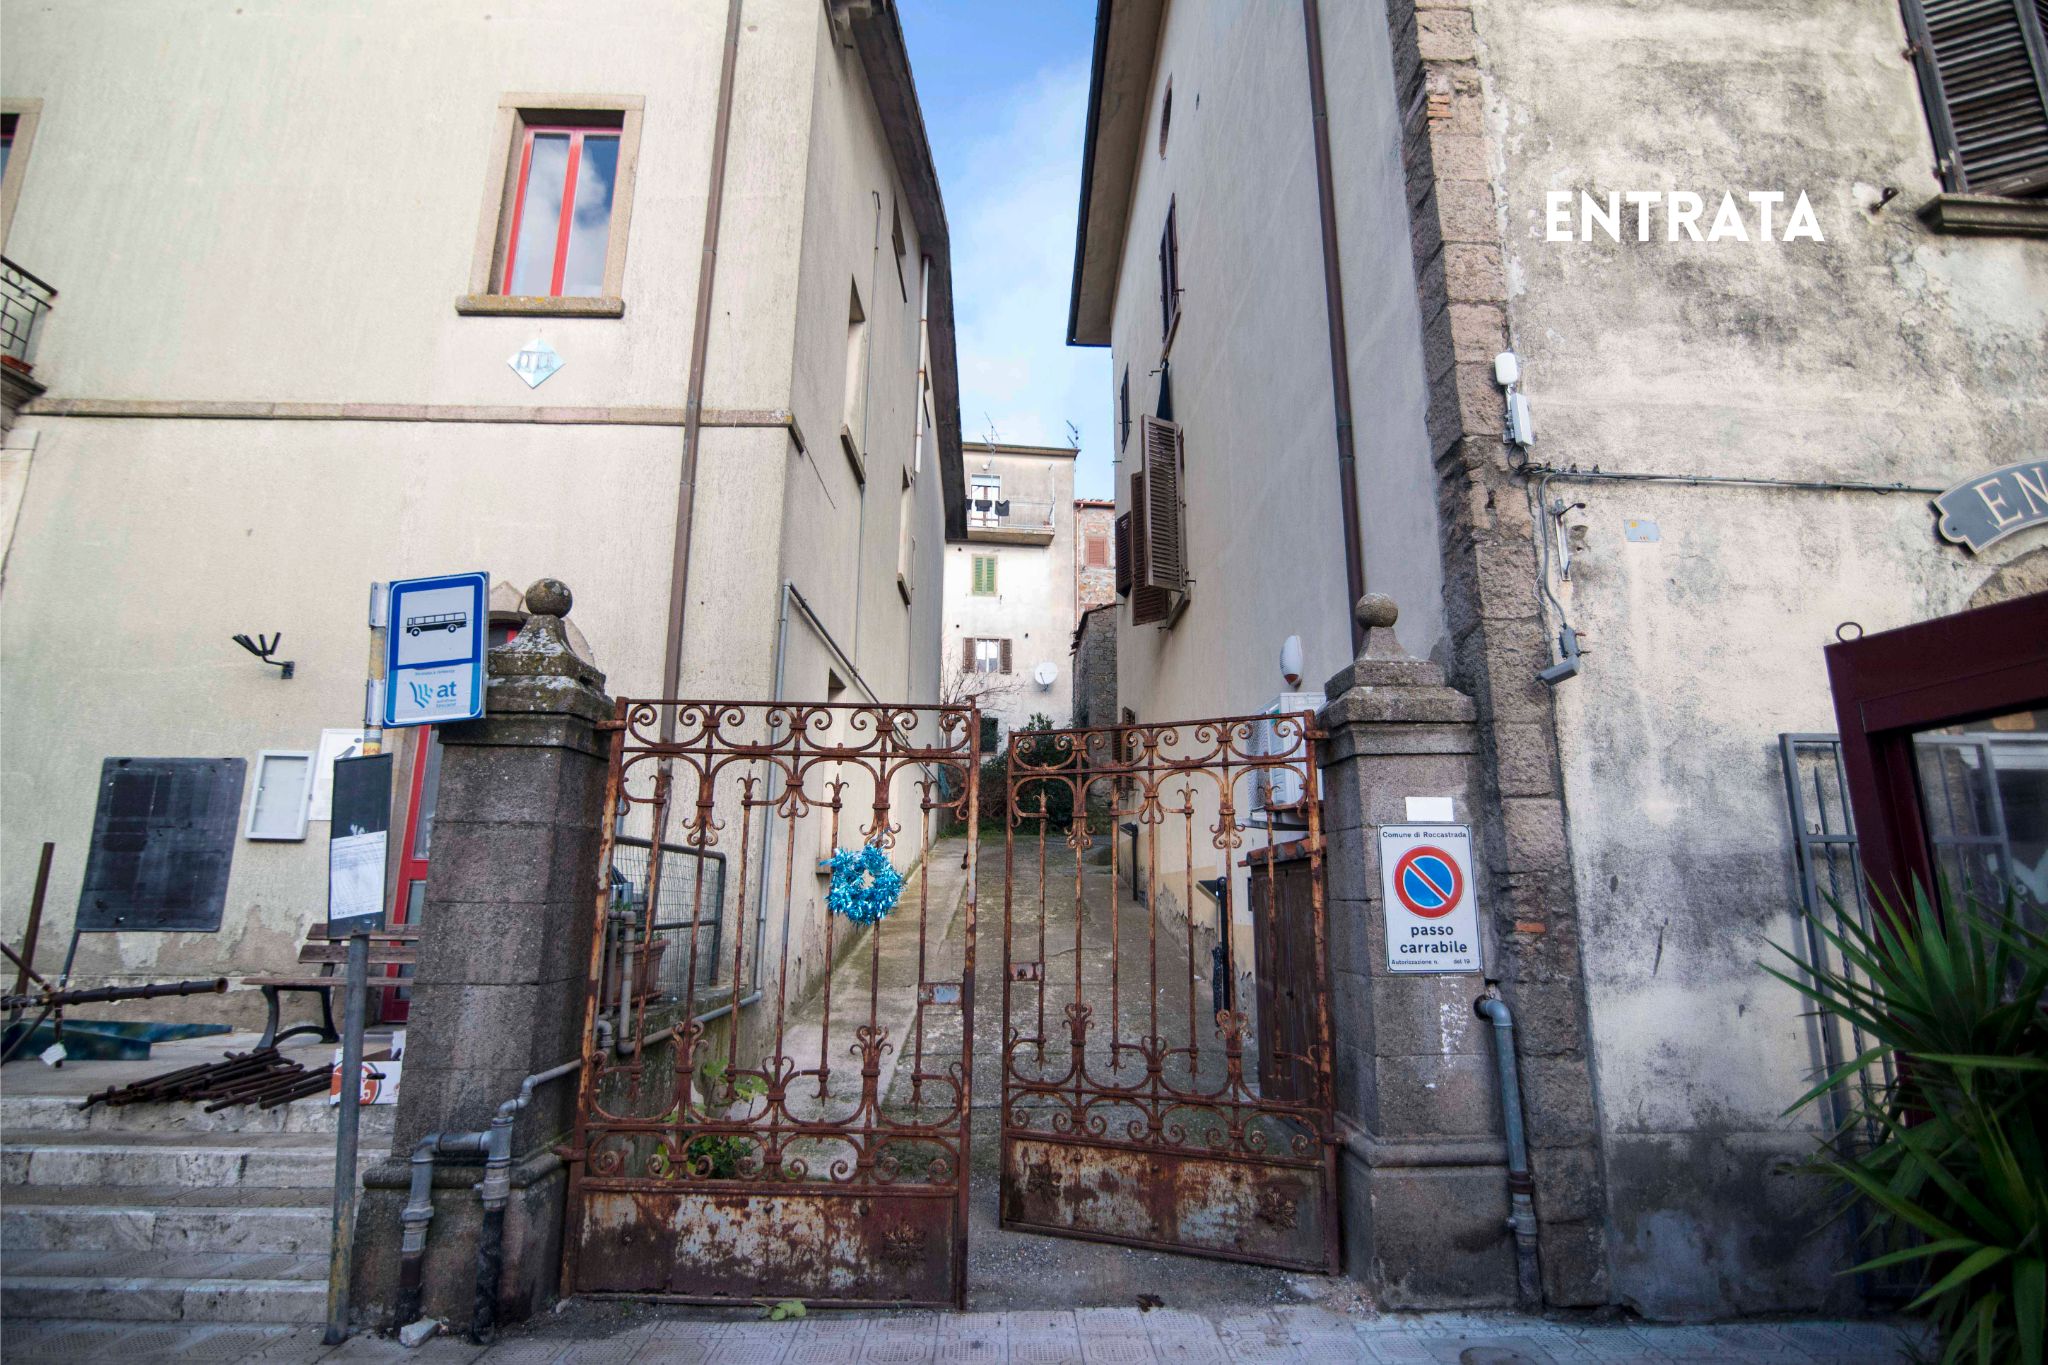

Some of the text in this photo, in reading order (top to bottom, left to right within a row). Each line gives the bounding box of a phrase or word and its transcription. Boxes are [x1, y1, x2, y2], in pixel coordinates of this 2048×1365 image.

[436, 681, 457, 698] at
[1410, 926, 1454, 938] passo
[1400, 940, 1468, 954] carrabile
